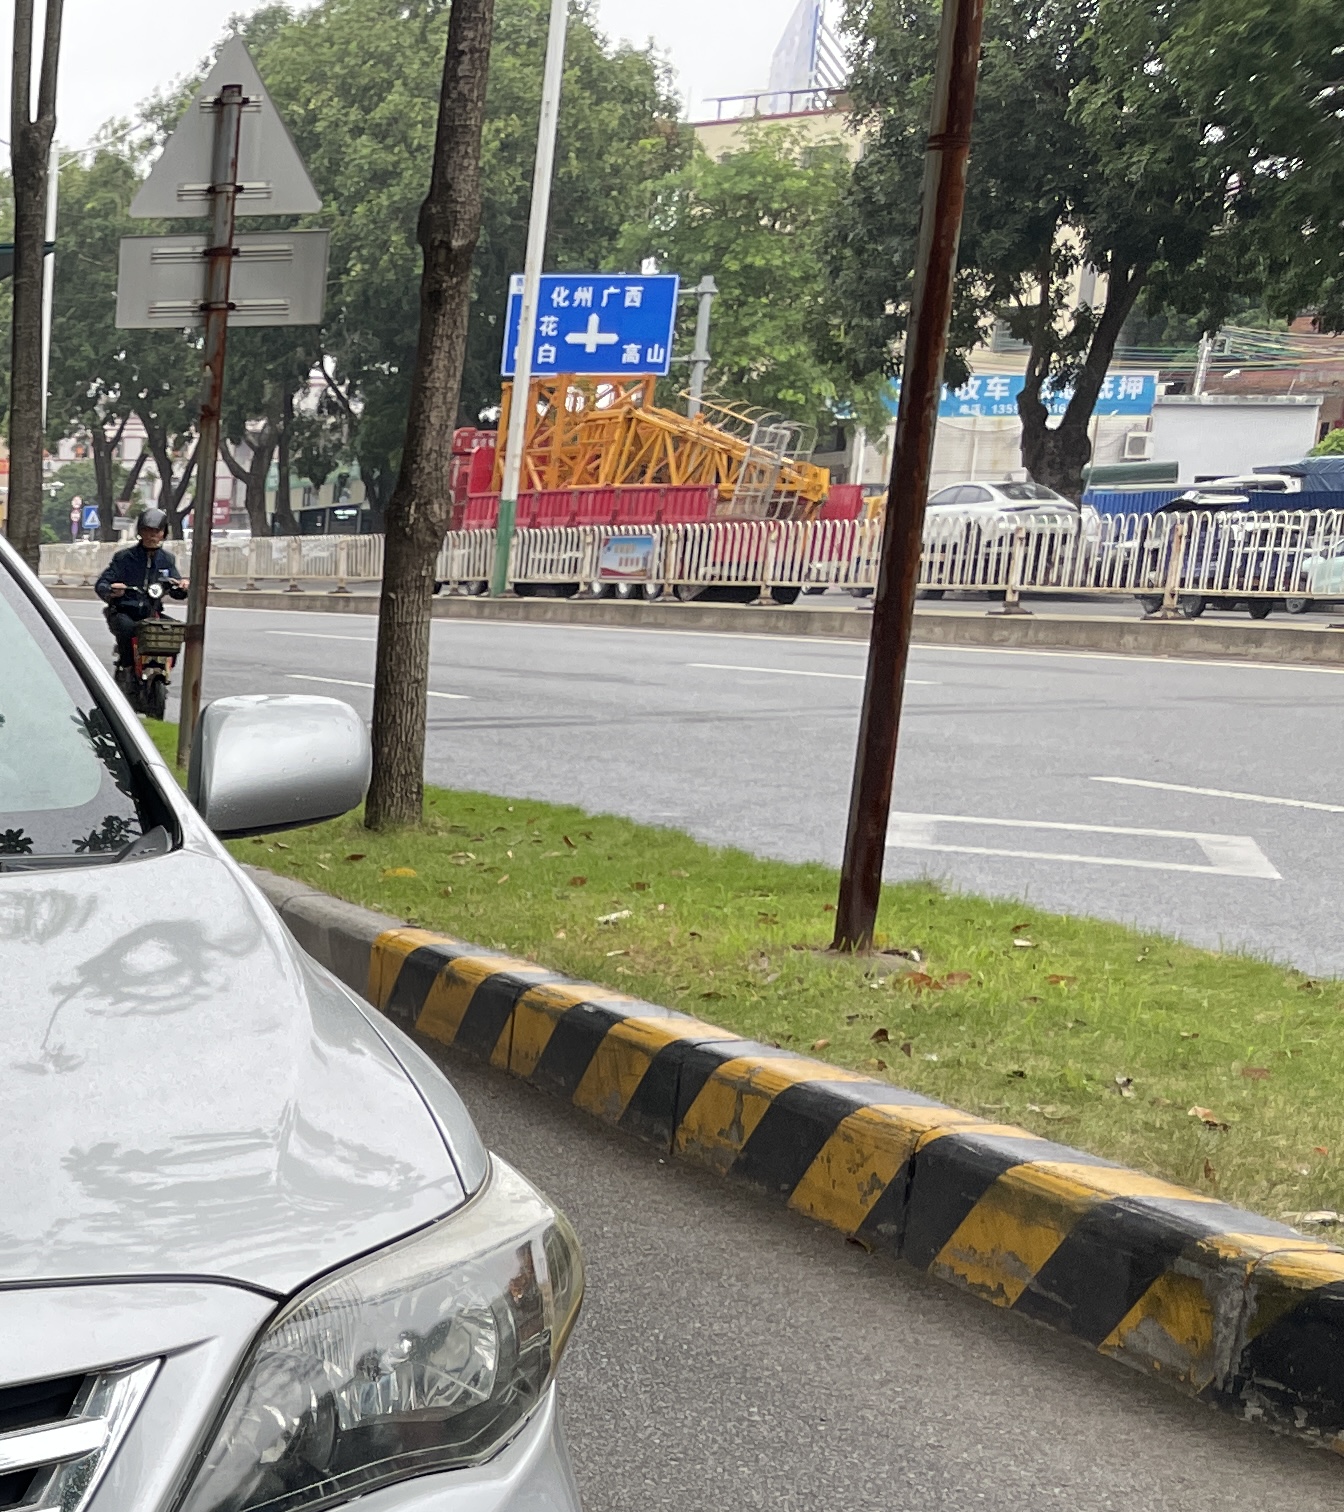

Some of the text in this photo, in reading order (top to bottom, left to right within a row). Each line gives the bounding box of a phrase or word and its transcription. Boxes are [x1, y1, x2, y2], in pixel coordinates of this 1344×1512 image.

[550, 286, 644, 309] 化州 广西
[621, 344, 665, 365] 高山
